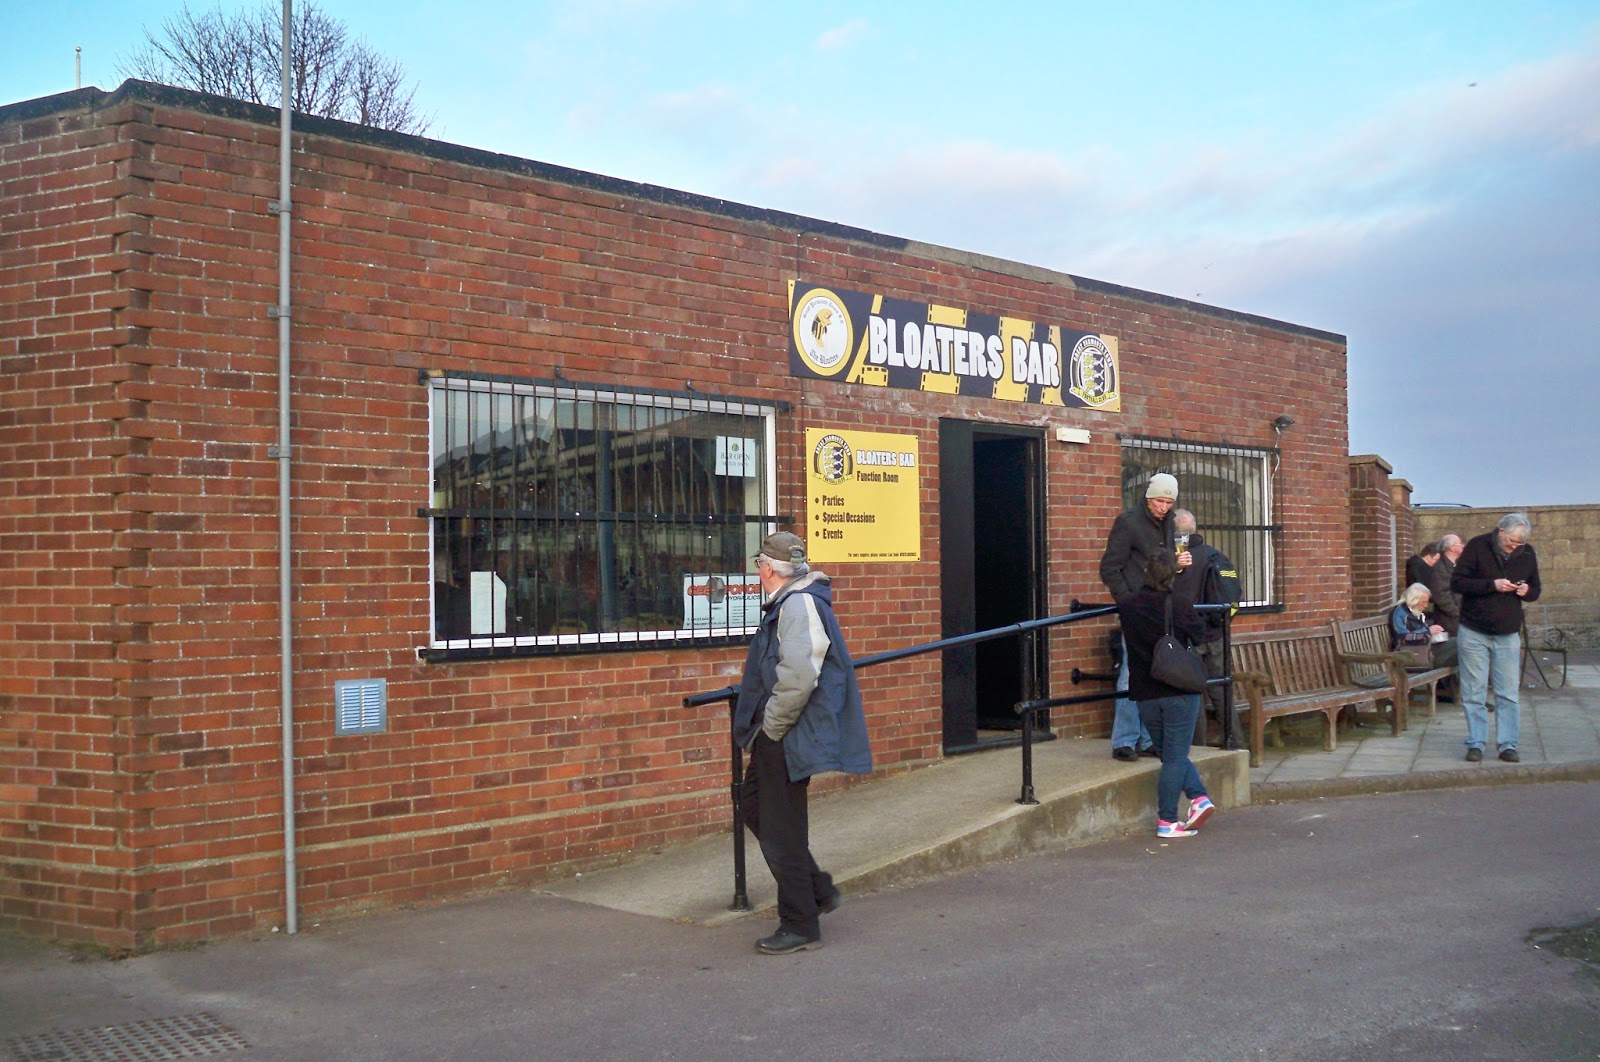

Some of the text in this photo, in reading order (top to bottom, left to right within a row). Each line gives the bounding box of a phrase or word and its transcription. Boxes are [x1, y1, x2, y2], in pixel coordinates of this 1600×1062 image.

[868, 316, 1061, 387] BLOATERS BAR
[856, 449, 916, 467] BLOATERS BAR
[856, 470, 882, 482] Function
[883, 472, 899, 483] Room
[822, 495, 845, 506] Parties
[823, 512, 876, 525] Special Occasions
[823, 528, 844, 539] Events
